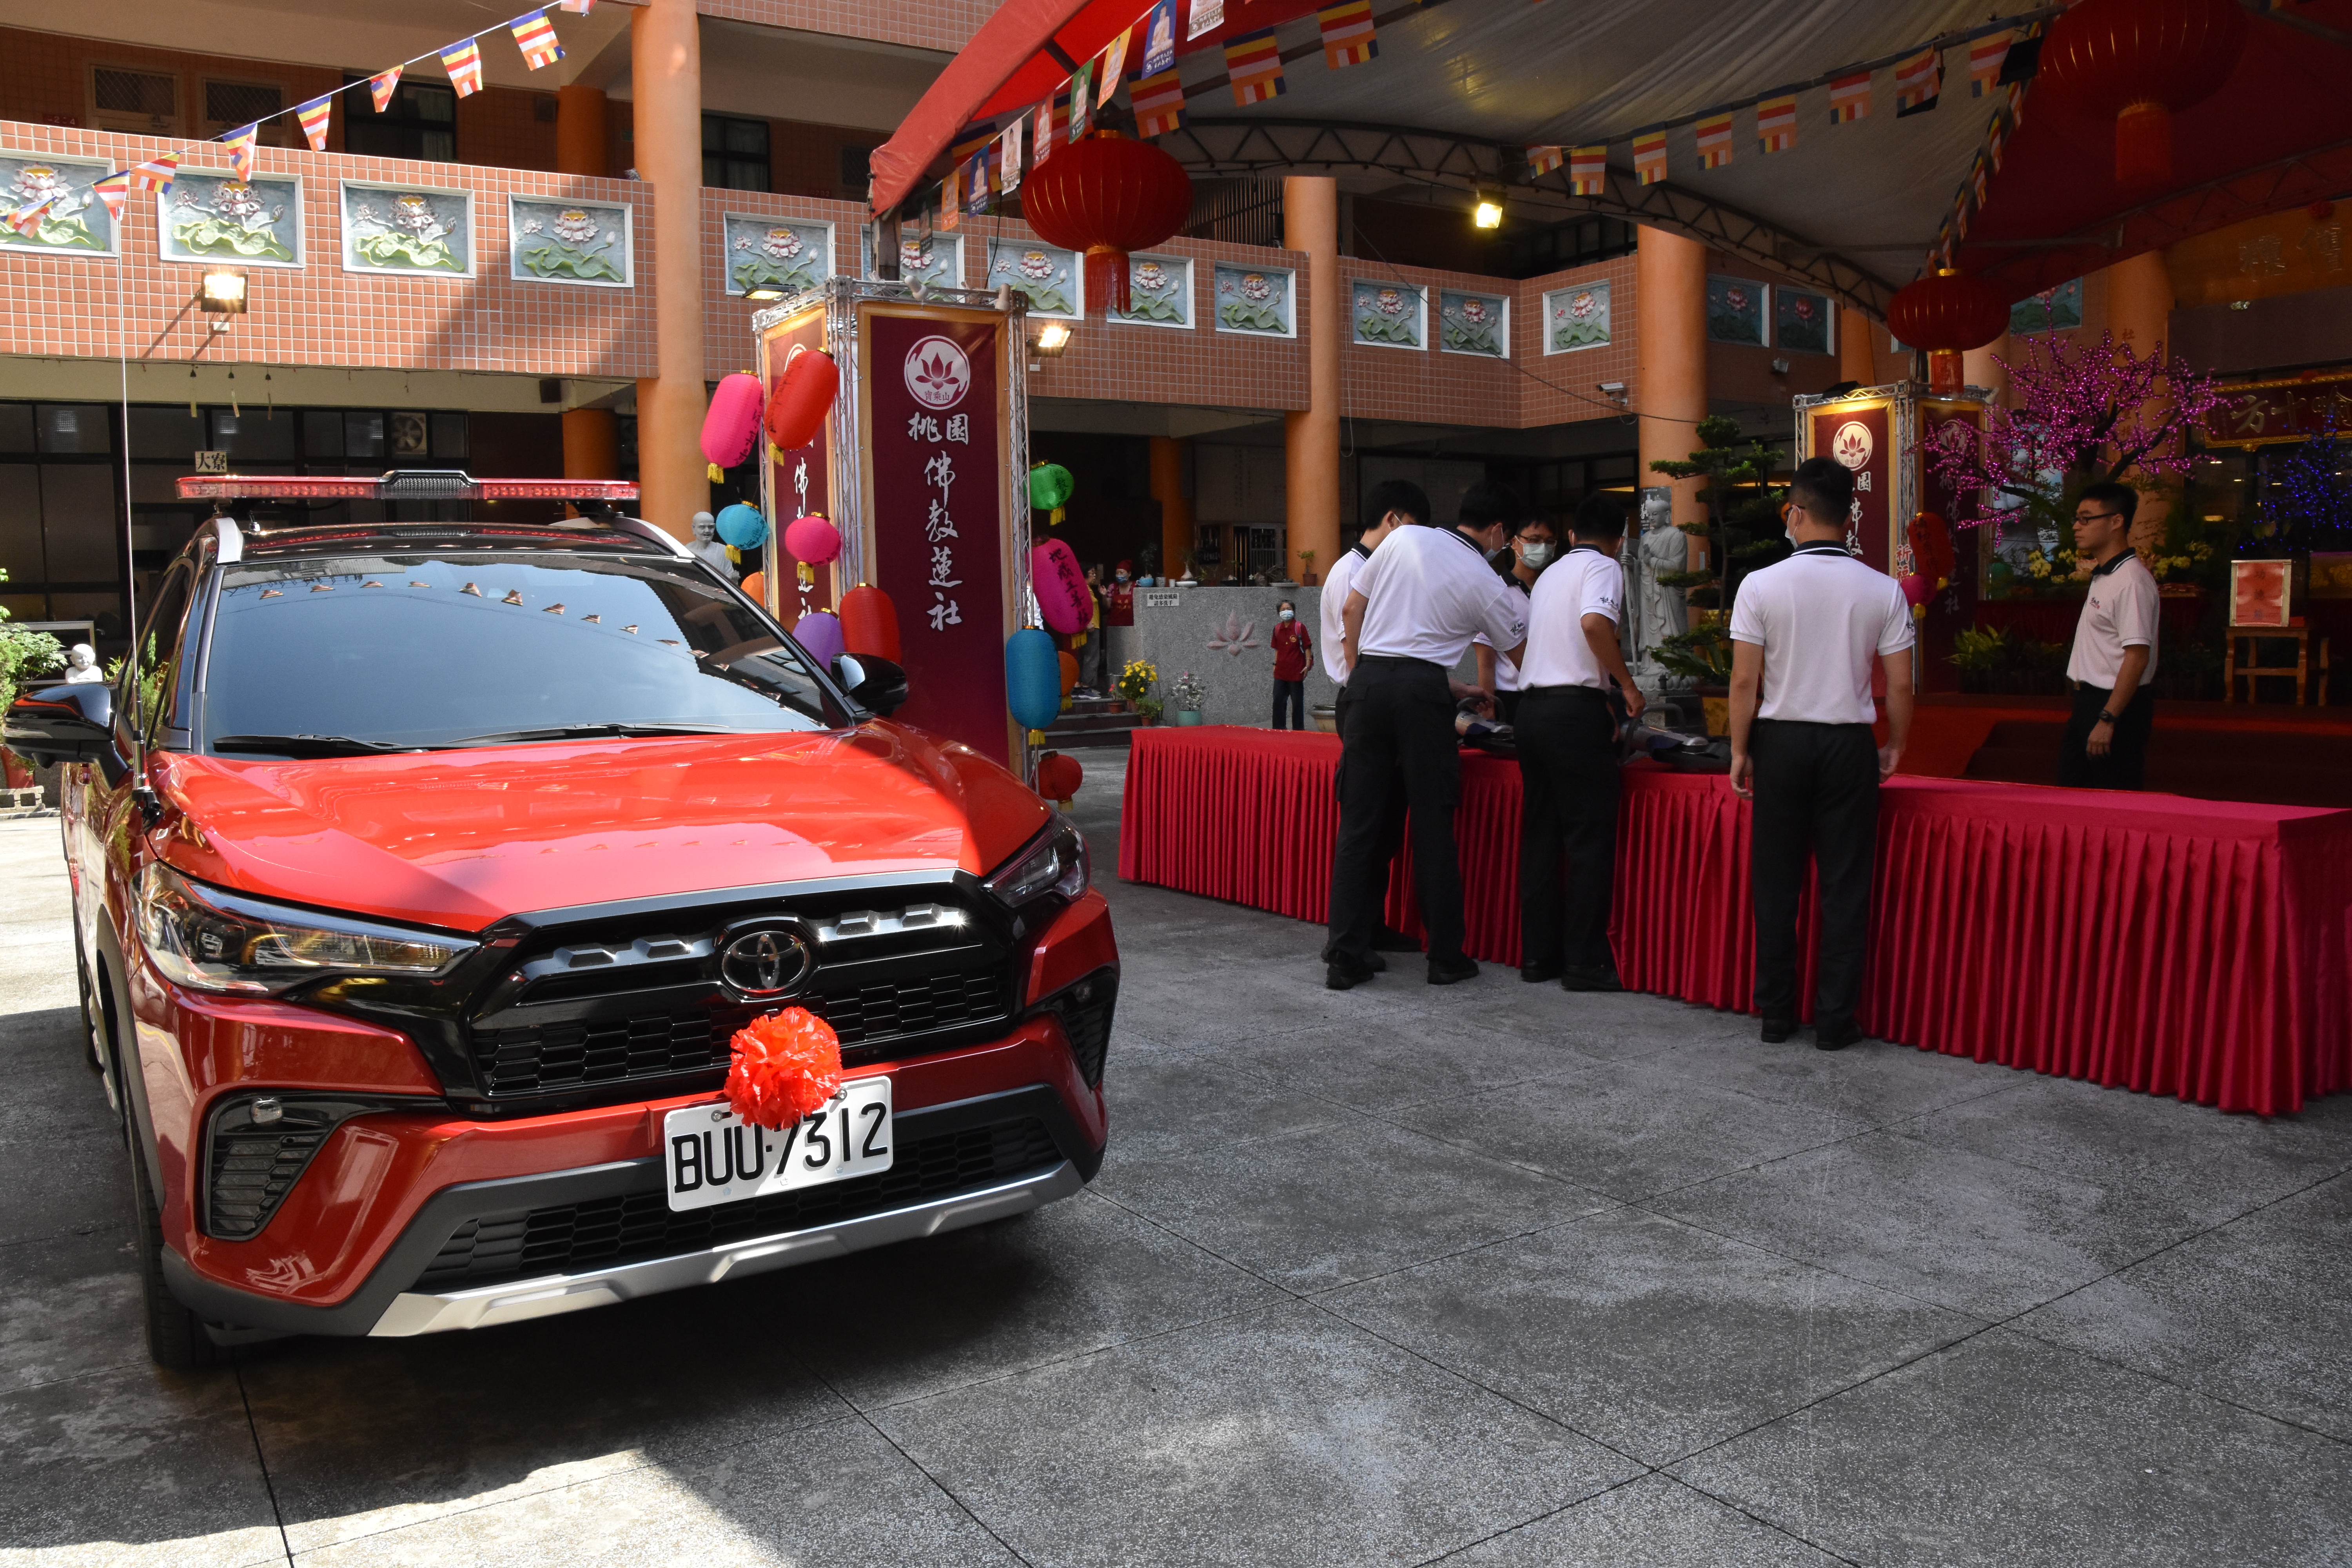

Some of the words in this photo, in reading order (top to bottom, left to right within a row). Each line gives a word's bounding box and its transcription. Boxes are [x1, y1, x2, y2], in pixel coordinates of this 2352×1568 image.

[924, 390, 950, 401] 寶乘山
[907, 412, 969, 445] 桃園
[197, 453, 225, 470] 大寮
[1852, 471, 1871, 492] 園
[924, 450, 963, 631] 佛教蓮社
[1896, 544, 1913, 583] 祈福
